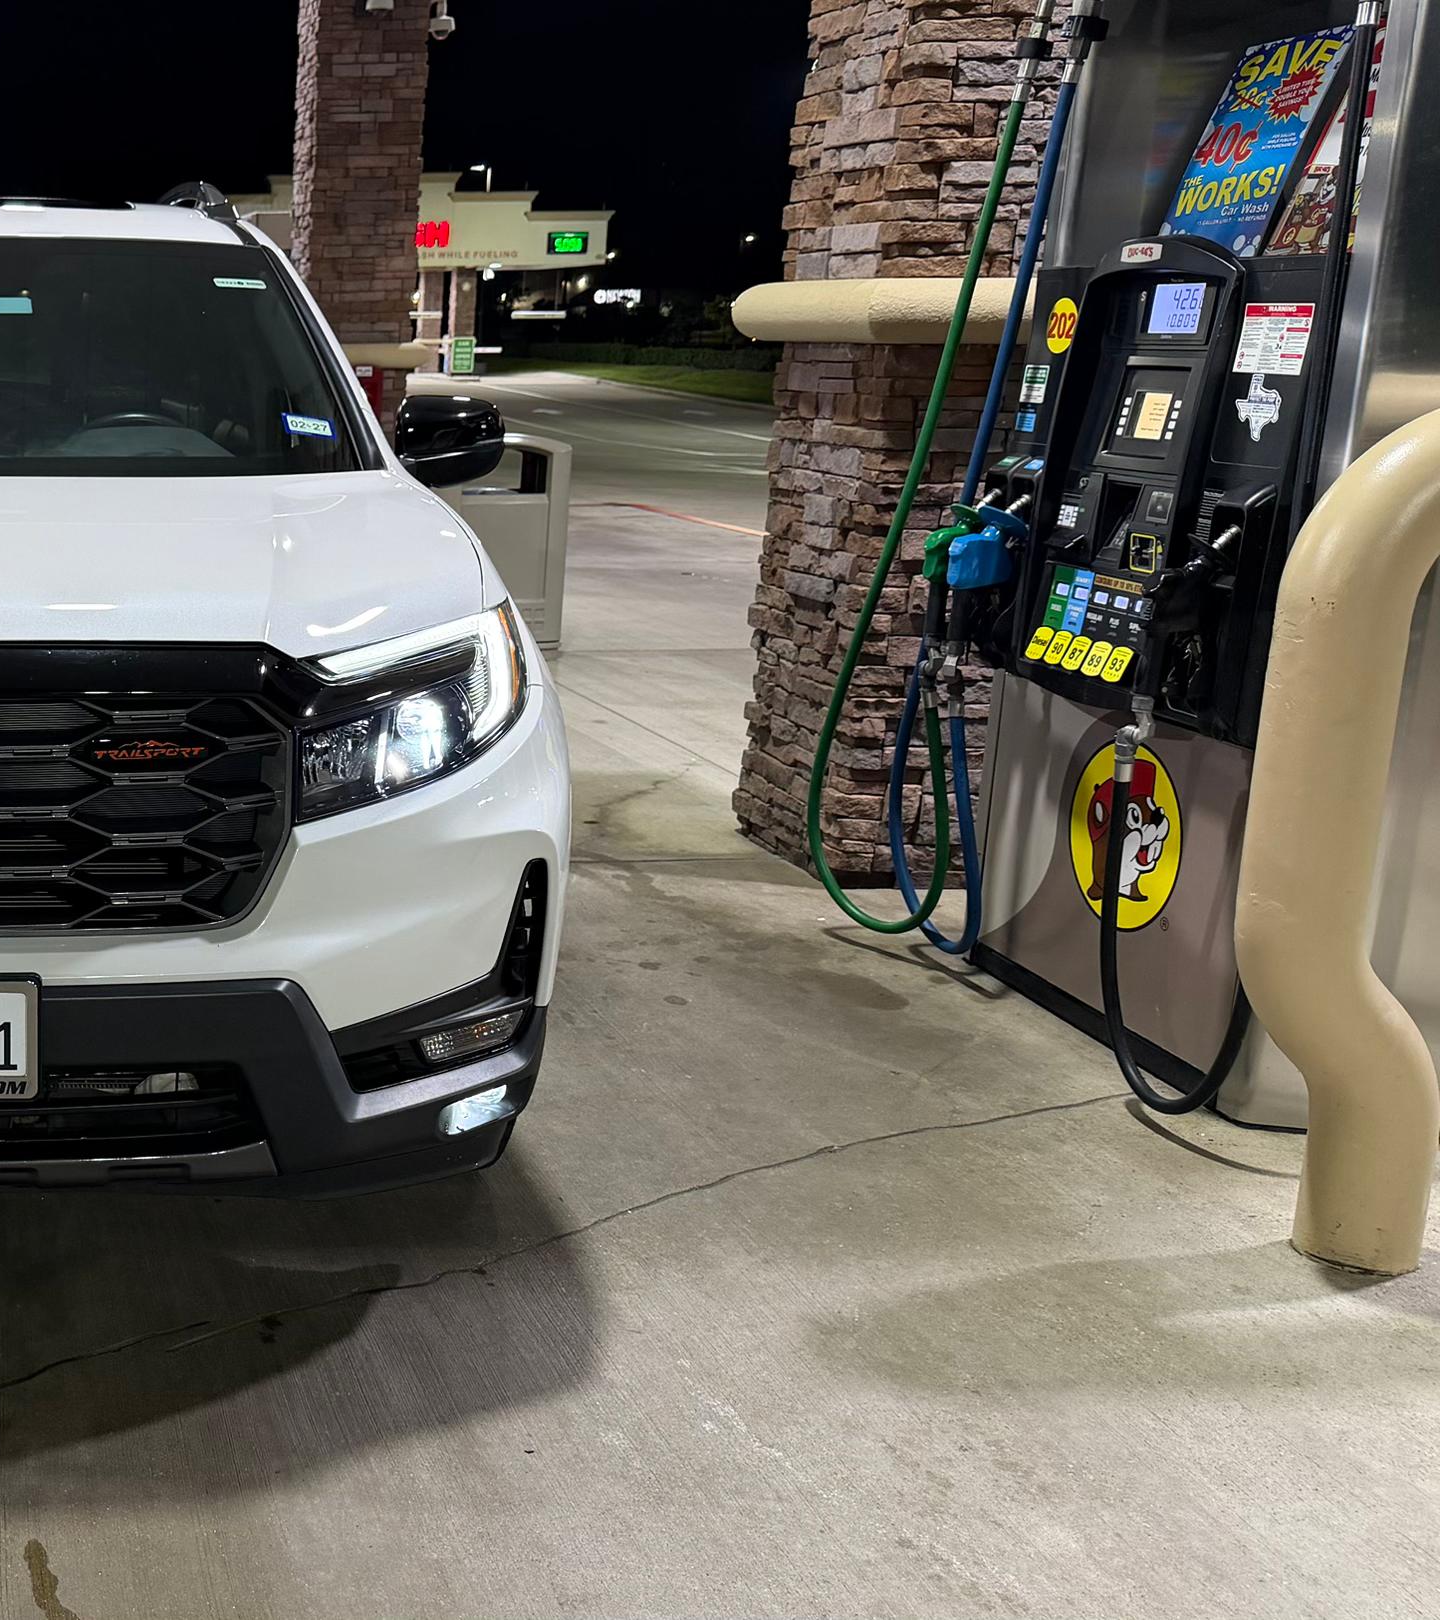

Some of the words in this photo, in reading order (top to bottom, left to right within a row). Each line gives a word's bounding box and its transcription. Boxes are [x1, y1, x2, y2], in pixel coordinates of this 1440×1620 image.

[1235, 39, 1344, 91] SAVE
[1193, 120, 1264, 174] 40¢
[1183, 175, 1204, 188] THE
[1175, 164, 1286, 218] WORKS!
[1221, 205, 1237, 217] Car
[1241, 201, 1270, 214] Wash
[437, 251, 470, 259] WHILE
[472, 250, 519, 259] FUELING
[1047, 312, 1076, 339] 202
[1031, 635, 1048, 647] Diesel
[1051, 642, 1064, 655] 90
[1068, 647, 1084, 661] 87
[1087, 654, 1102, 668] 89
[1109, 657, 1125, 672] 93
[94, 747, 205, 760] TRAILSPORT
